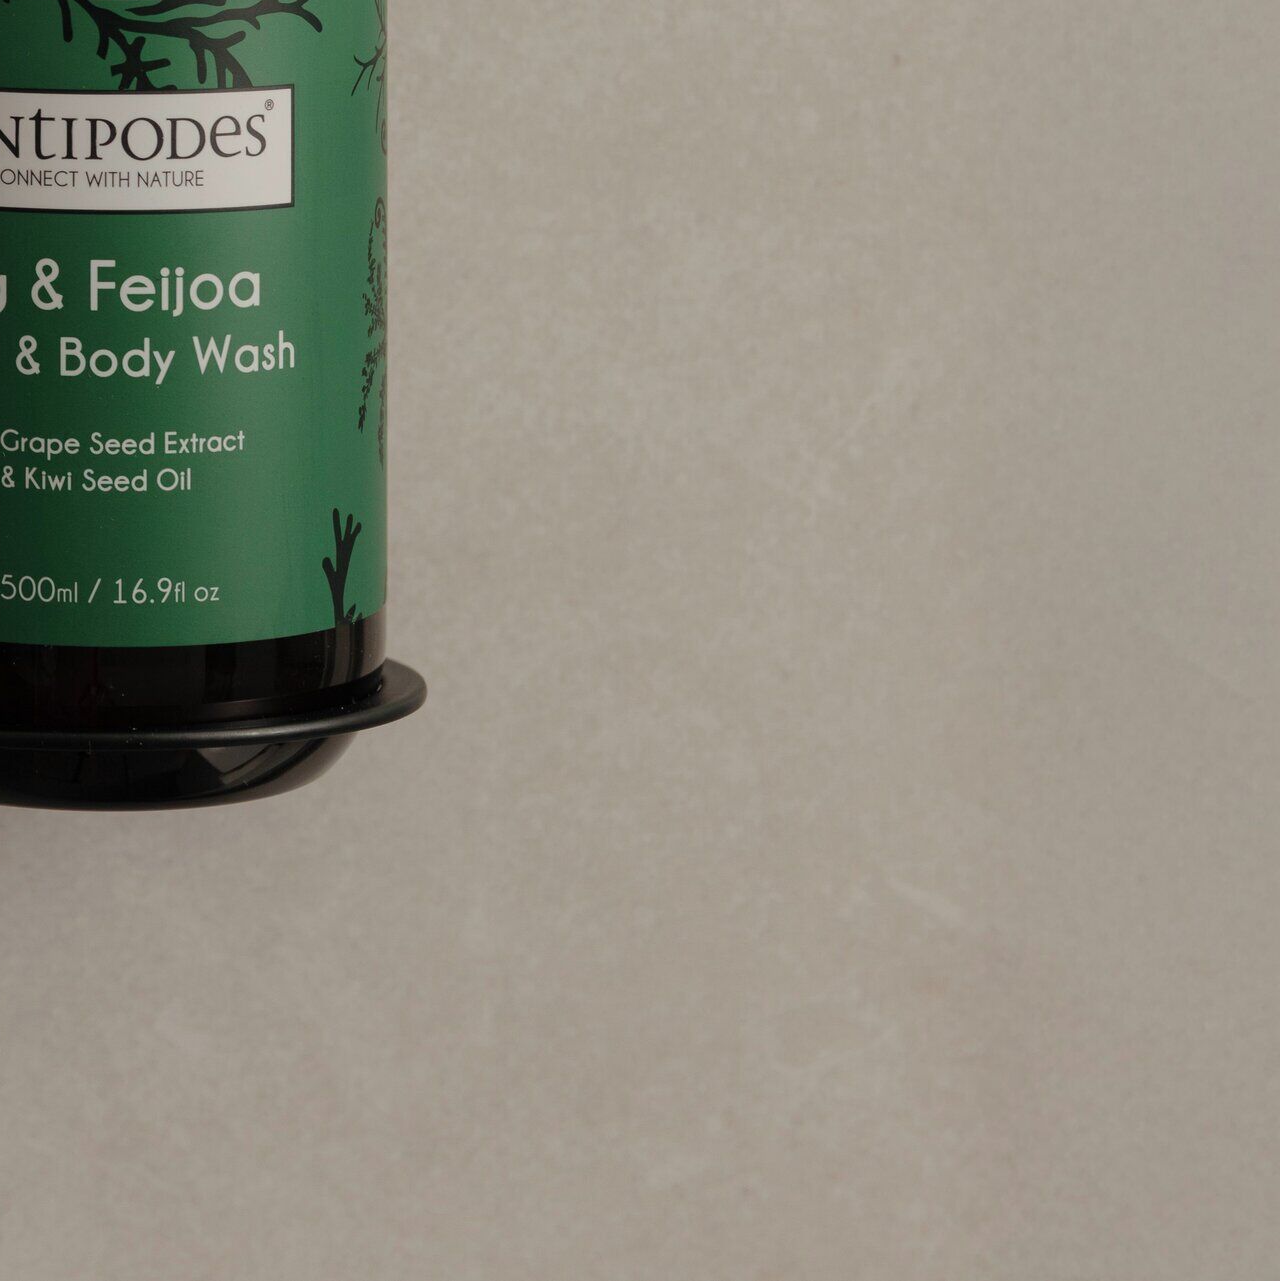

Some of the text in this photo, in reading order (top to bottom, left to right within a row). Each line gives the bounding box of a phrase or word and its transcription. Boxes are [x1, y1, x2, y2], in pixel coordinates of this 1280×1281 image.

[84, 170, 131, 188] WITH
[136, 169, 204, 188] NATURE
[30, 257, 64, 311] &
[90, 259, 260, 317] Feijoa
[15, 334, 41, 376] &
[59, 336, 176, 385] Body
[192, 330, 295, 374] Wash
[0, 428, 81, 461] Grape
[89, 431, 155, 455] Seed
[164, 430, 245, 455] Extract
[1, 465, 192, 492] & Kiwi Seed Oil
[193, 586, 220, 603] oz
